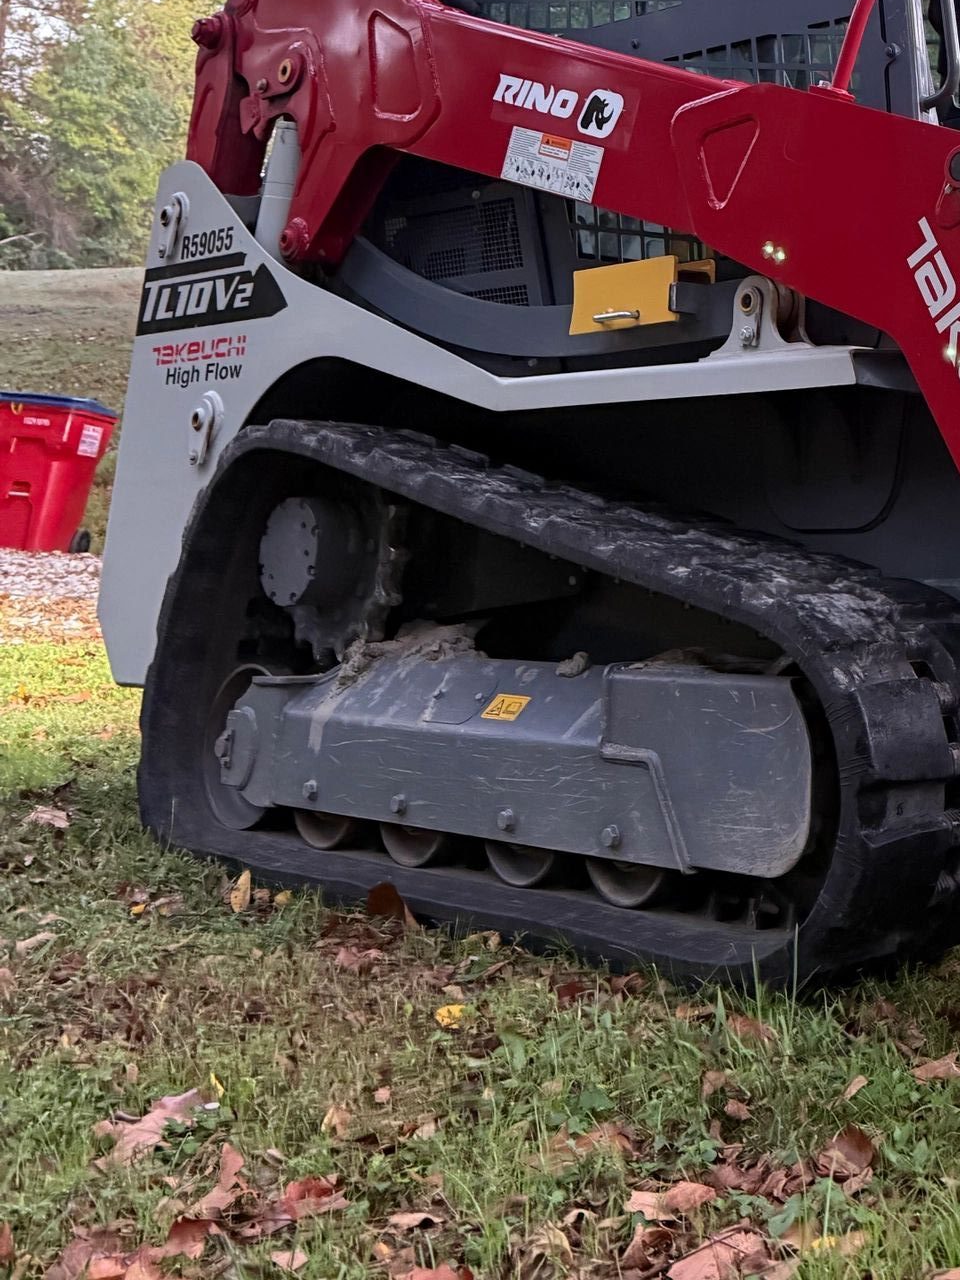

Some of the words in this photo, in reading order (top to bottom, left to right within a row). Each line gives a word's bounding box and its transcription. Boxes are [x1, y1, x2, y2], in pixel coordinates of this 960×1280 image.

[493, 73, 579, 119] RINO
[181, 226, 234, 260] R59055
[142, 275, 254, 322] TL10V2
[152, 335, 247, 366] TAKEUCHI
[165, 366, 200, 388] High
[204, 363, 243, 382] Flow
